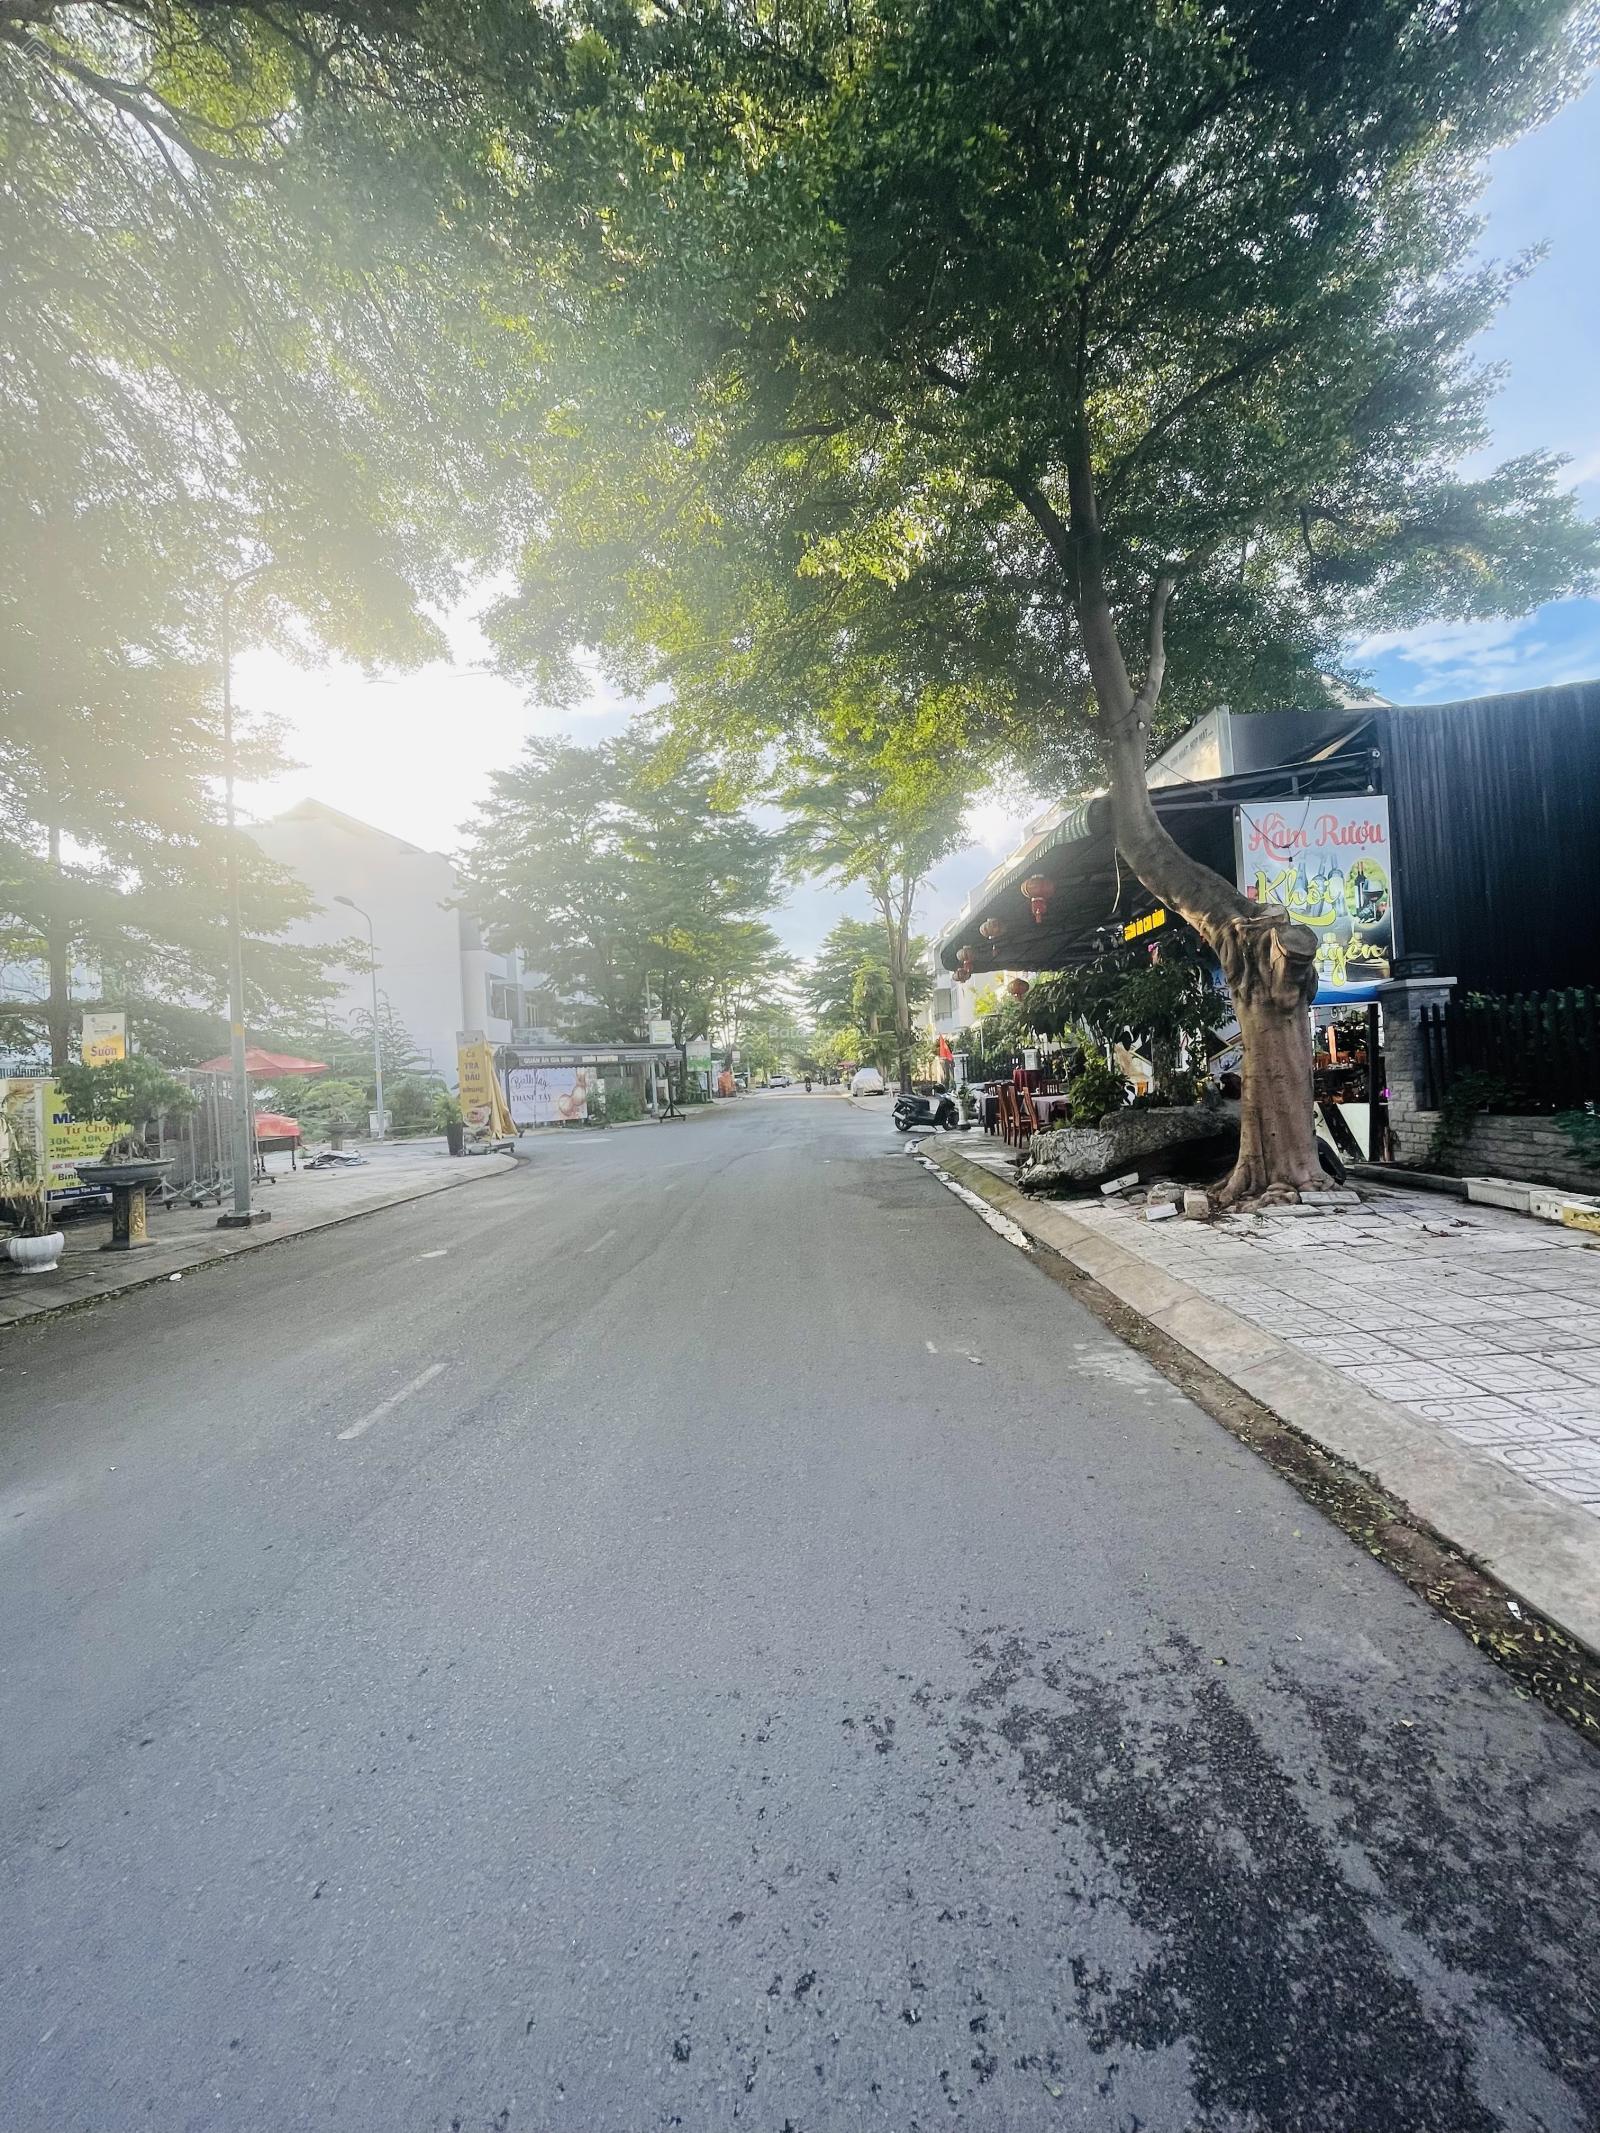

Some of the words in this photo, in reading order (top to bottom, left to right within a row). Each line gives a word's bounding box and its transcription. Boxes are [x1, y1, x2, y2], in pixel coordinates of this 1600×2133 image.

[1248, 812, 1311, 862] Hầm
[1314, 814, 1387, 850] Rượu
[1256, 867, 1337, 927] Khôi
